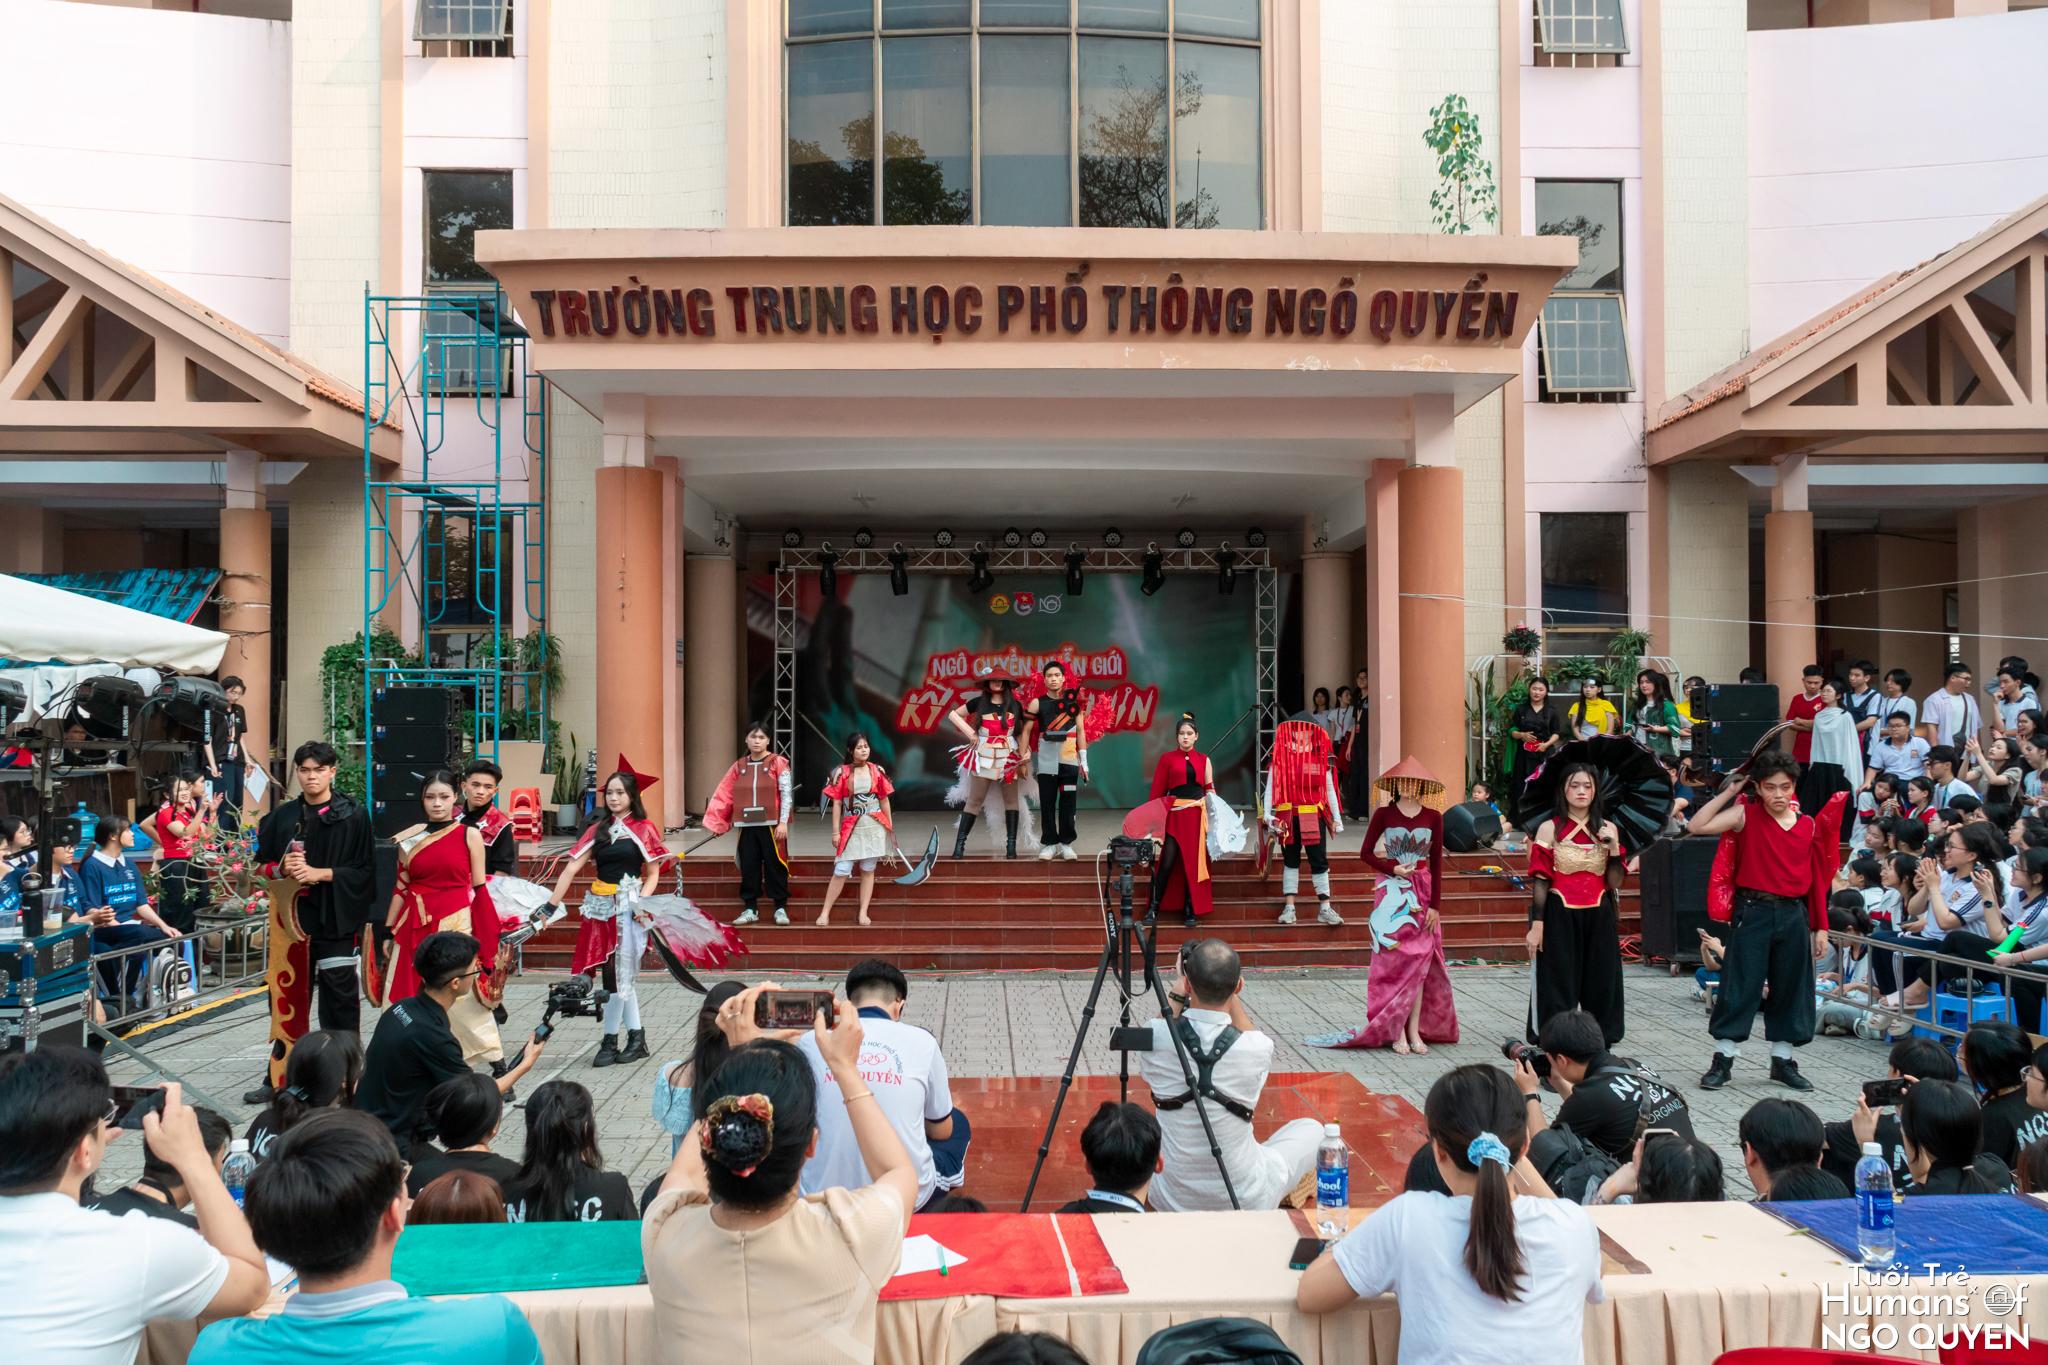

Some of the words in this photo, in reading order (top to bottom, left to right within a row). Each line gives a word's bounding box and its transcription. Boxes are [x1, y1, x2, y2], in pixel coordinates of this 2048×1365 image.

[530, 276, 716, 337] TRƯỜNG
[725, 283, 880, 336] TRUNG
[890, 283, 983, 344] HỌC
[997, 261, 1090, 334] PHỔ
[1102, 271, 1254, 335] THÔNG
[1265, 276, 1357, 337] NGÔ
[932, 652, 967, 677] NGÔ
[1092, 650, 1122, 676] GIỚI
